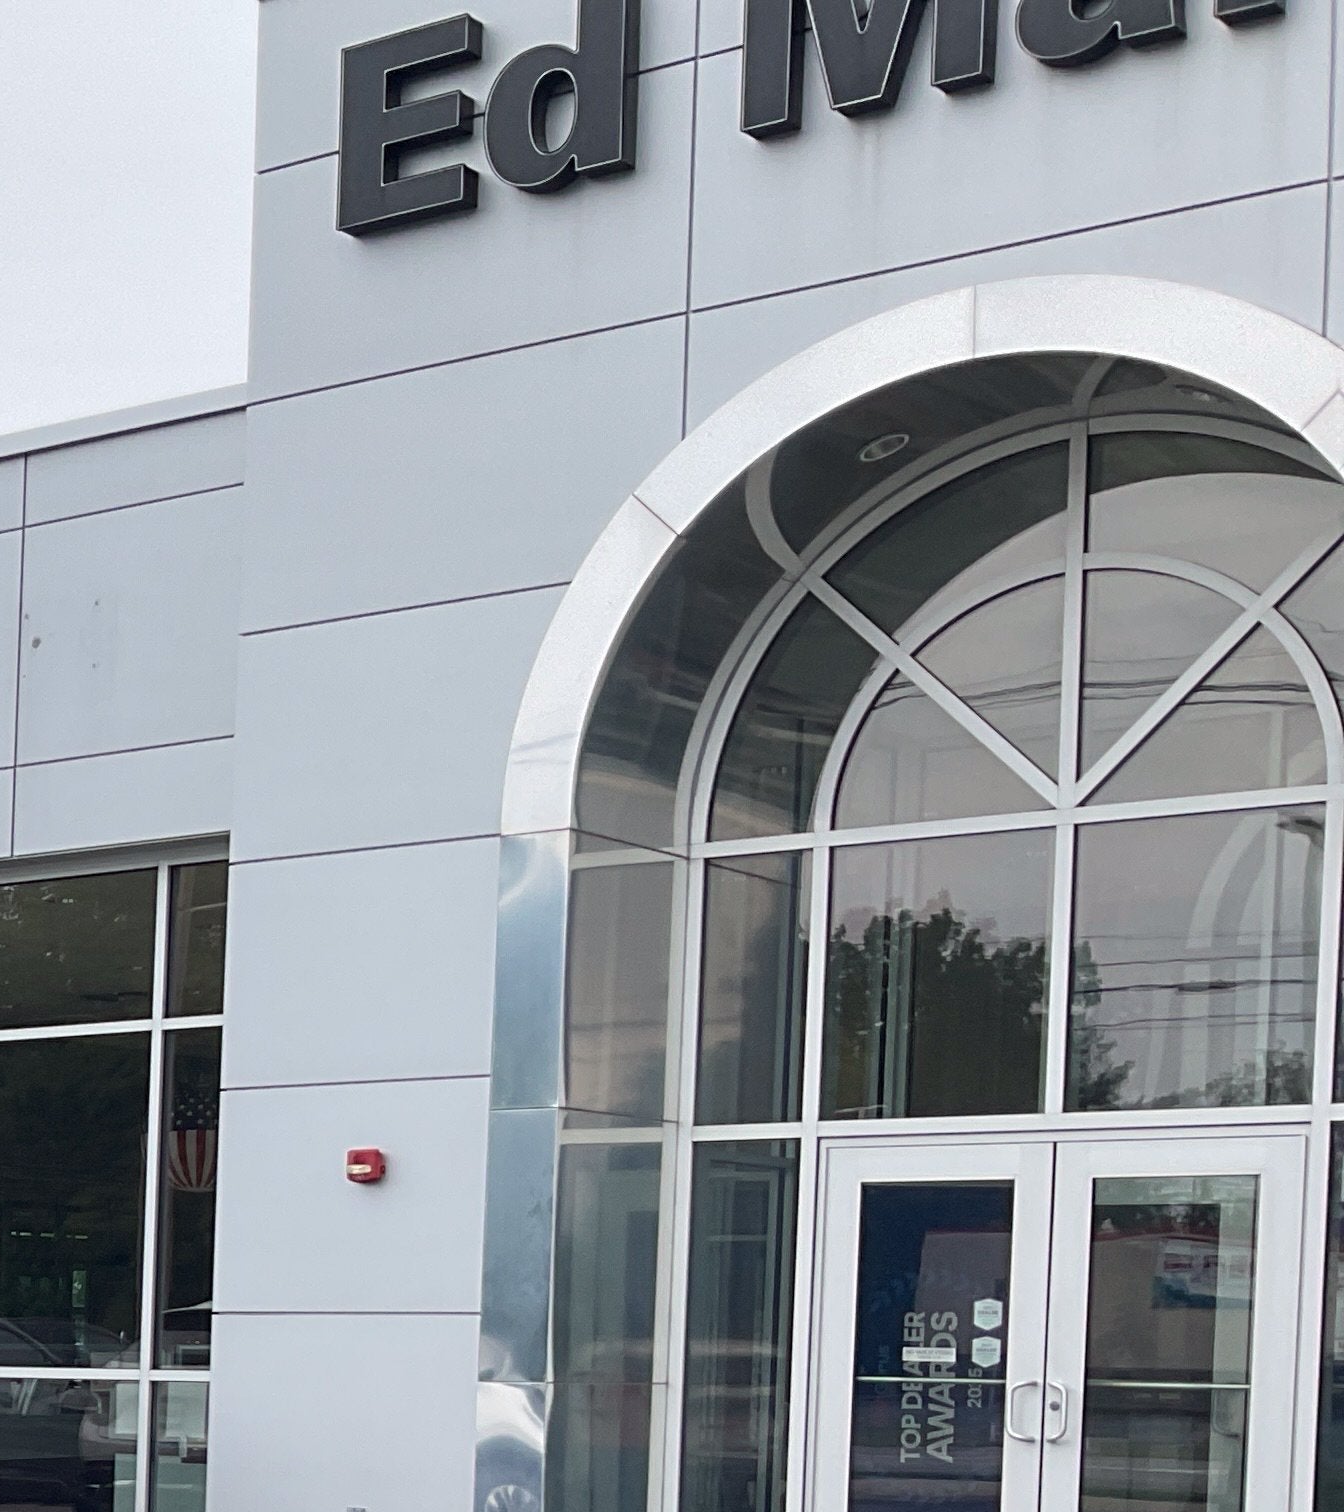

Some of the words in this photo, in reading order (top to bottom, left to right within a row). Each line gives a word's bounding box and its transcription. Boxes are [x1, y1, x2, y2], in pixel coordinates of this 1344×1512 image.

[336, 0, 637, 237] Ed
[901, 1311, 925, 1410] DEAER
[926, 1311, 958, 1464] AWARDS
[967, 1368, 982, 1408] 205
[900, 1414, 921, 1463] TOP
